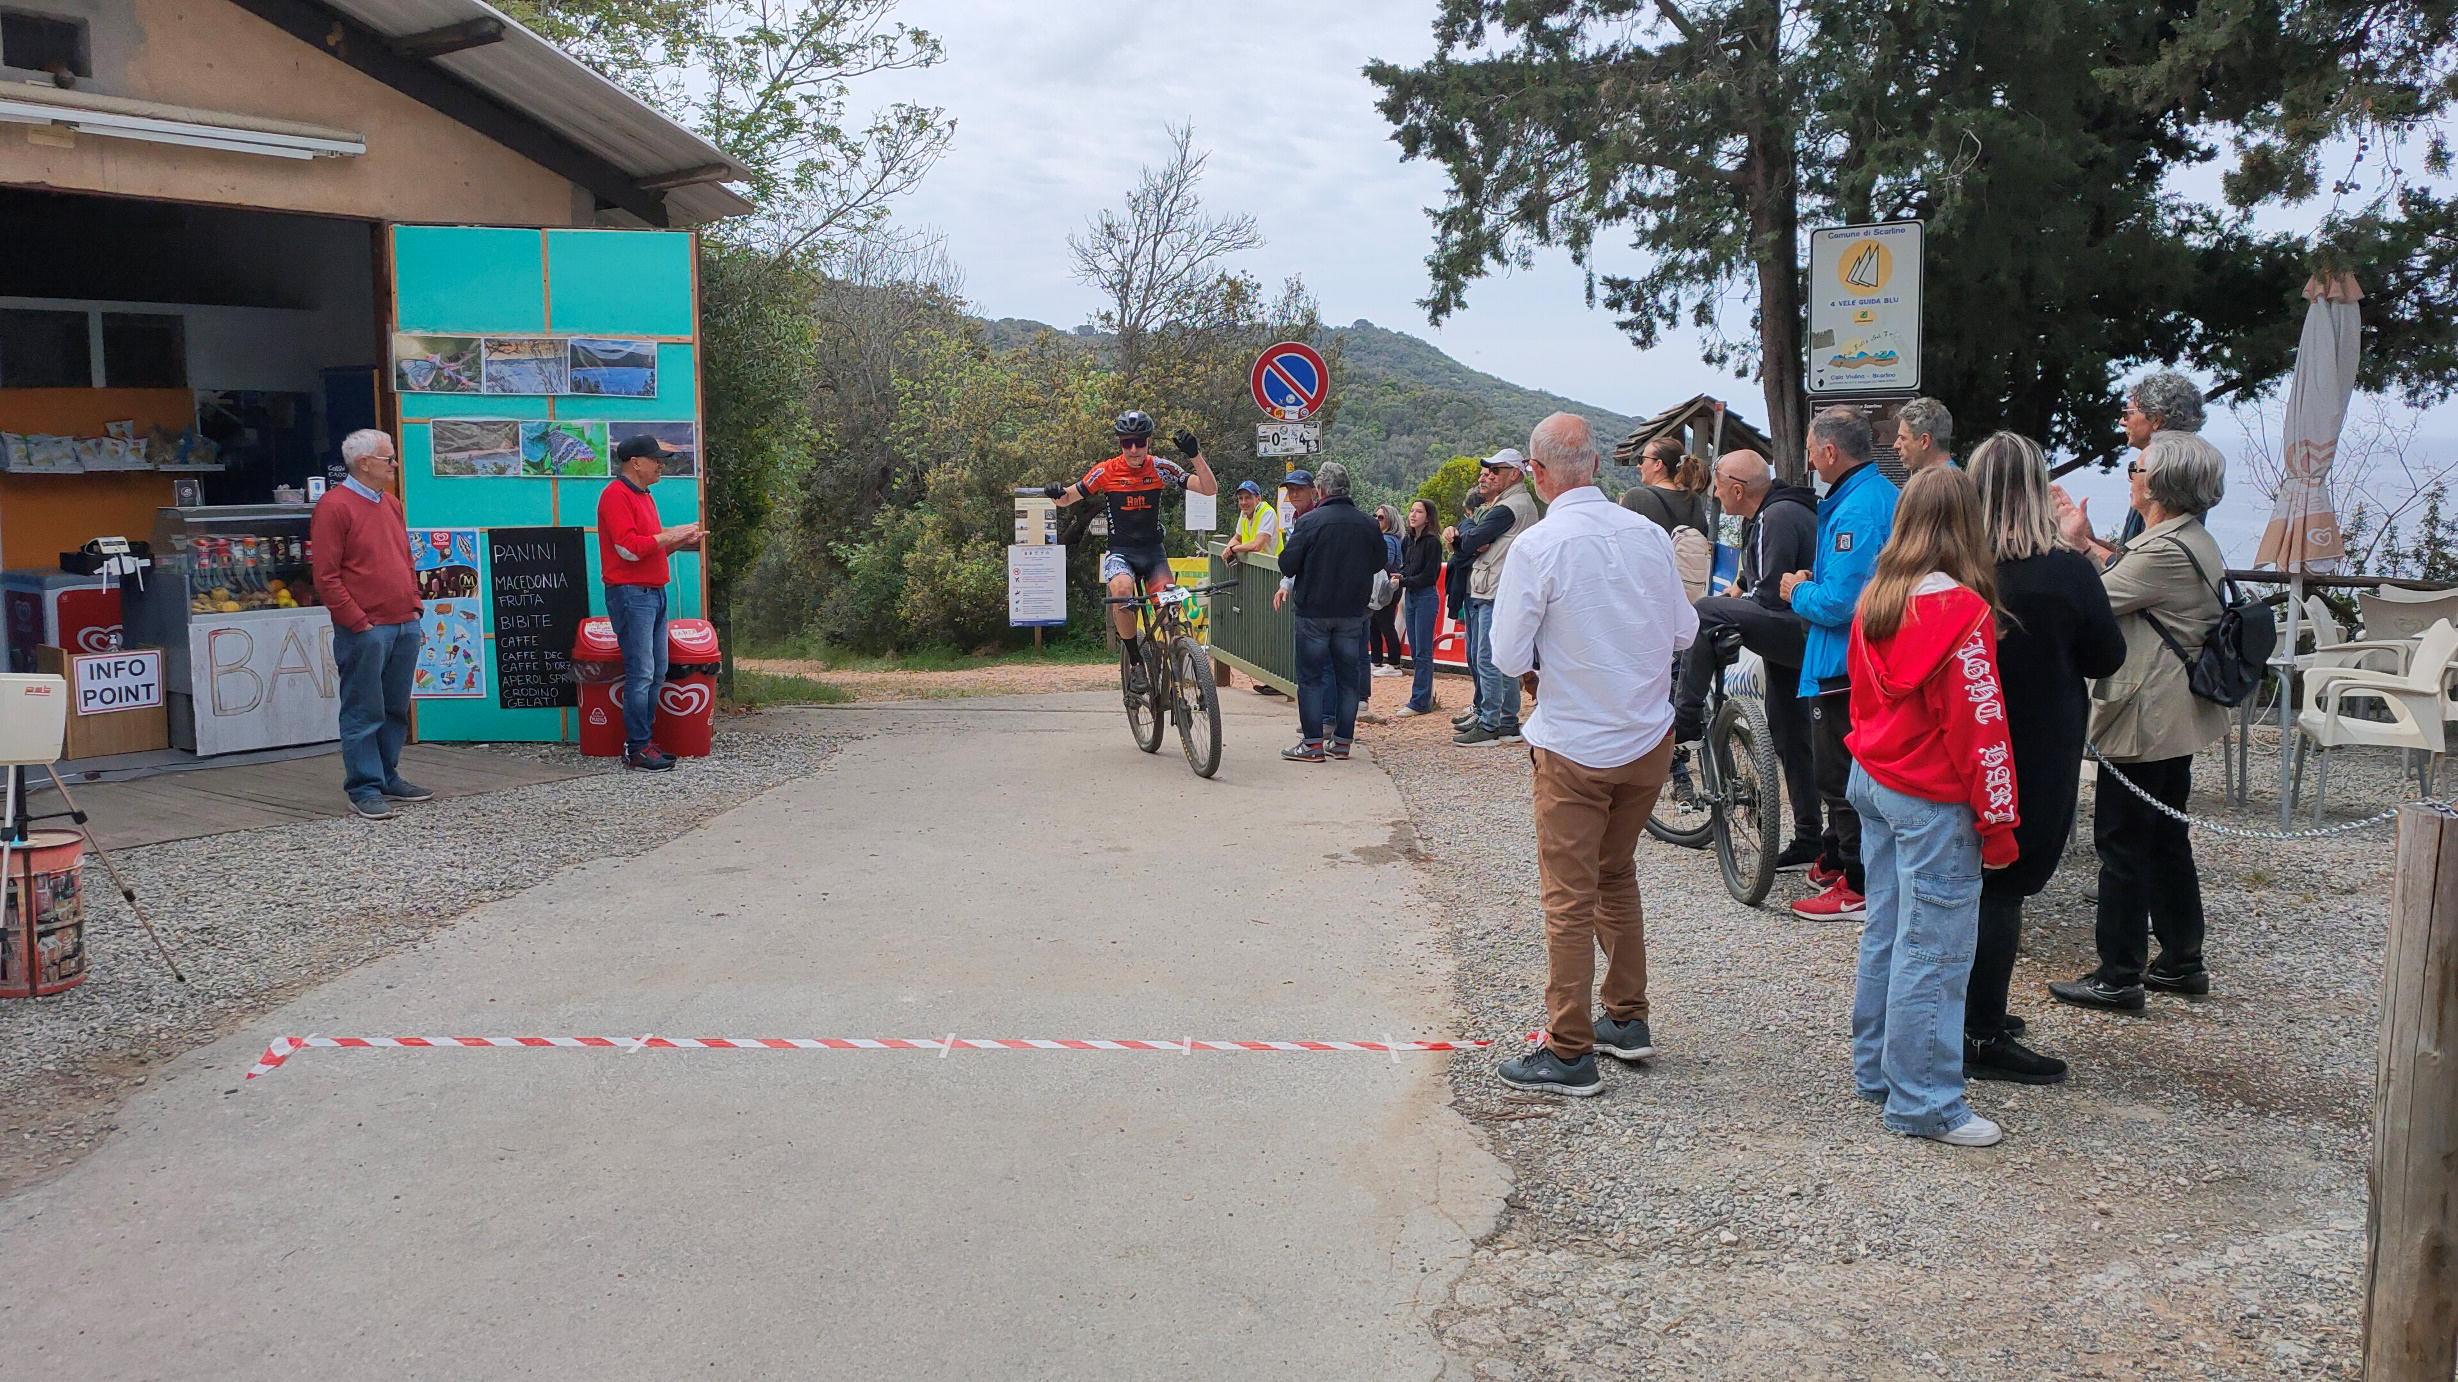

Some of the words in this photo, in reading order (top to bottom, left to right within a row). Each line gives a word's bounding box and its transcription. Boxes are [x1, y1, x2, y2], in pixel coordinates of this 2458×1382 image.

[1828, 231, 1860, 240] Comune
[1873, 227, 1906, 236] Scarlino
[1838, 299, 1856, 307] VELE
[494, 543, 556, 564] PANINI
[495, 572, 568, 591] MACEDONIA
[498, 593, 545, 607] FRUTTA
[500, 614, 553, 630] BIBITE
[502, 651, 538, 661] CAFFE
[543, 650, 564, 660] DEC
[89, 659, 146, 681] INFO
[501, 661, 539, 673] CAFFE
[502, 674, 547, 688] APEROL
[1956, 631, 2004, 725] IGHT
[83, 683, 155, 707] POINT
[503, 687, 559, 699] CRODINO
[507, 697, 557, 708] GELATI
